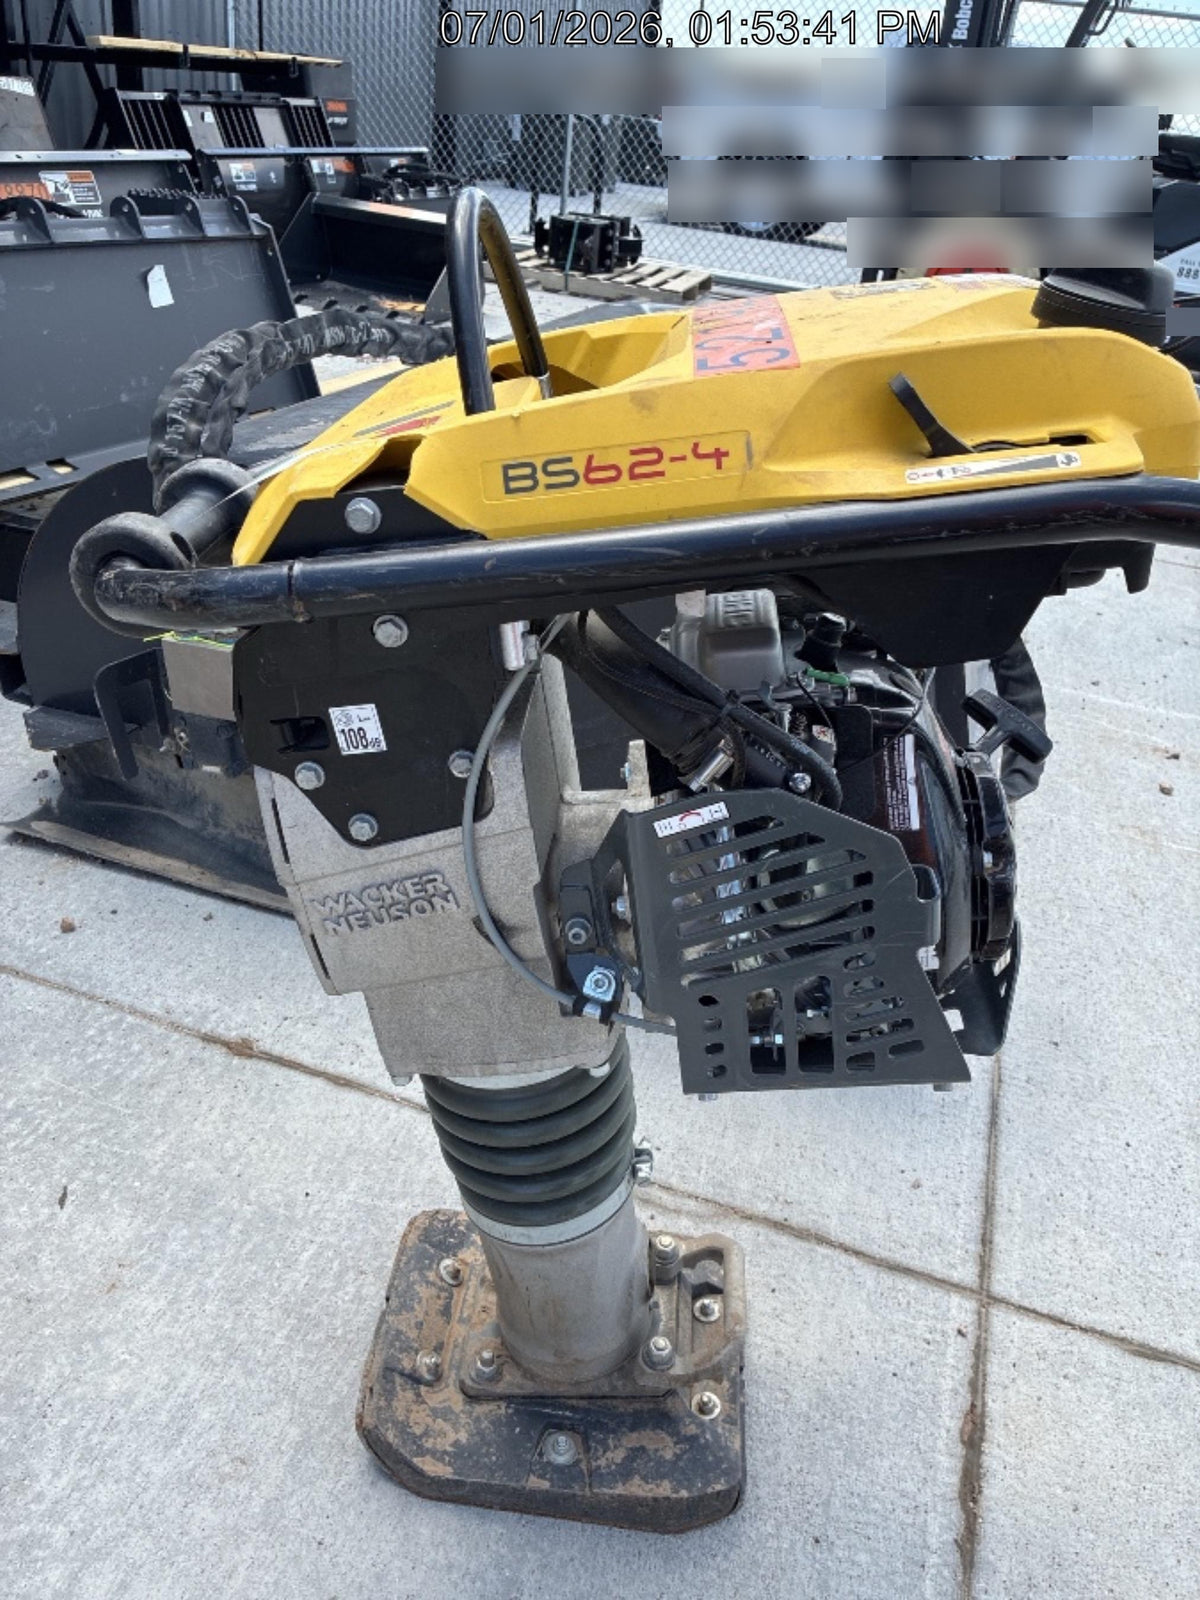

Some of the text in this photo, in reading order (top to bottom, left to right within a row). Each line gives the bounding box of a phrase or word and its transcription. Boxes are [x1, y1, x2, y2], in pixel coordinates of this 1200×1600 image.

[502, 442, 730, 494] BS62-4
[340, 727, 369, 751] 108
[310, 872, 451, 916] WACKER
[322, 892, 460, 934] NEUSON
